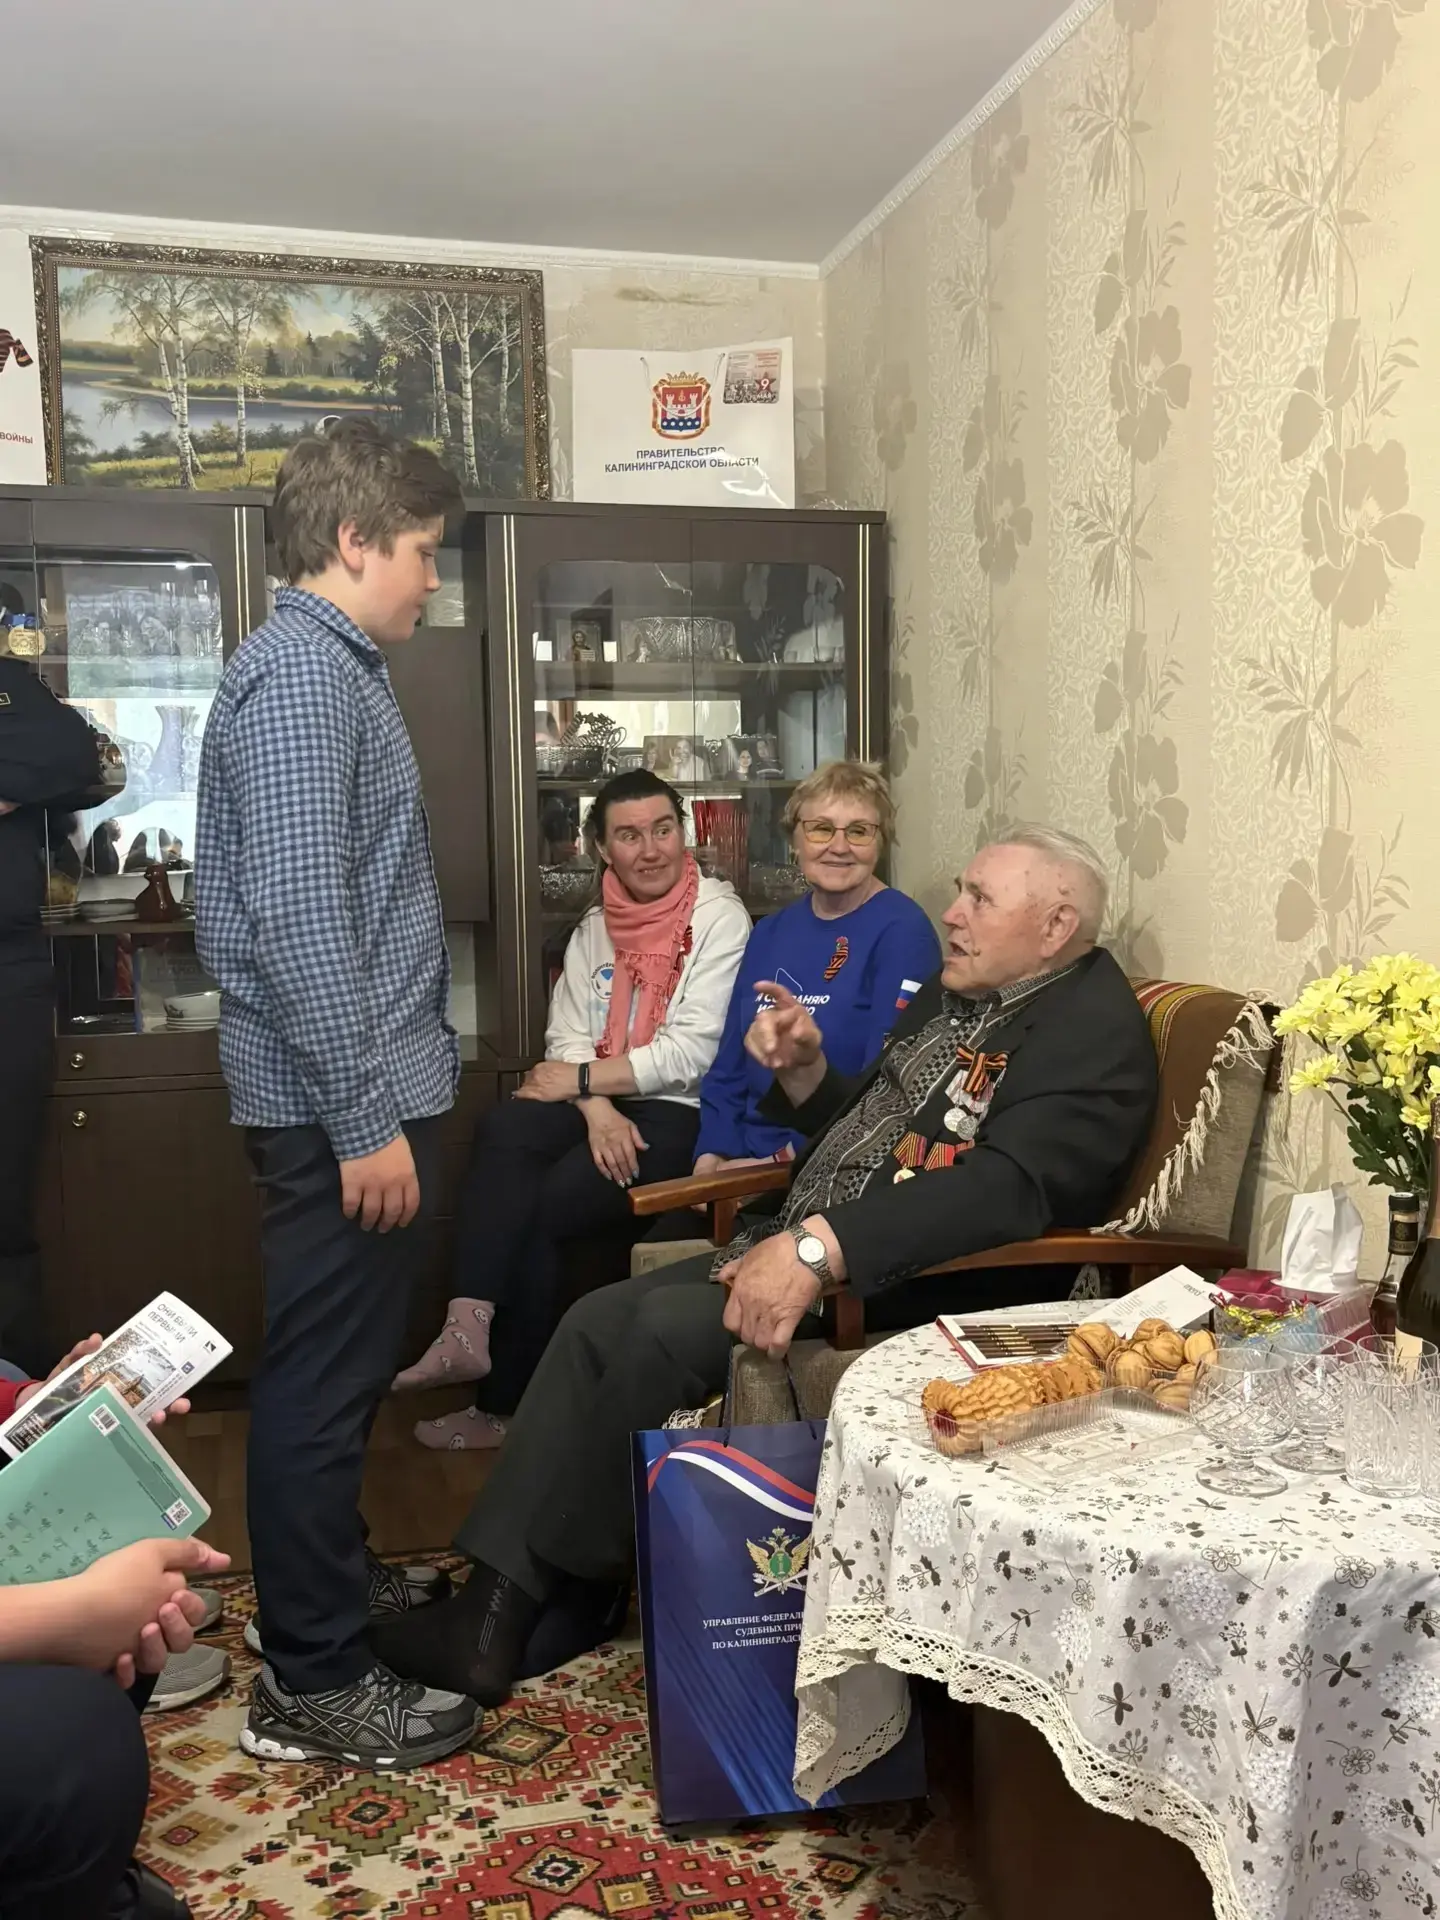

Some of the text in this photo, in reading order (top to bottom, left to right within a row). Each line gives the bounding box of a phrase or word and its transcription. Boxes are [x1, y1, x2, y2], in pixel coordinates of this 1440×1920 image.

[761, 378, 769, 390] 9
[0, 432, 33, 444] ВОЙНЫ
[604, 457, 759, 473] КАЛИНИНГРАДСКОЙ ОБЛАСТИ
[764, 994, 830, 1004] САНЯЮ
[157, 1303, 176, 1317] ОНИ
[702, 1615, 760, 1629] УПРАВЛЕНИЕ
[735, 1624, 783, 1636] СУДЕБНЫХ
[712, 1641, 726, 1649] ПО
